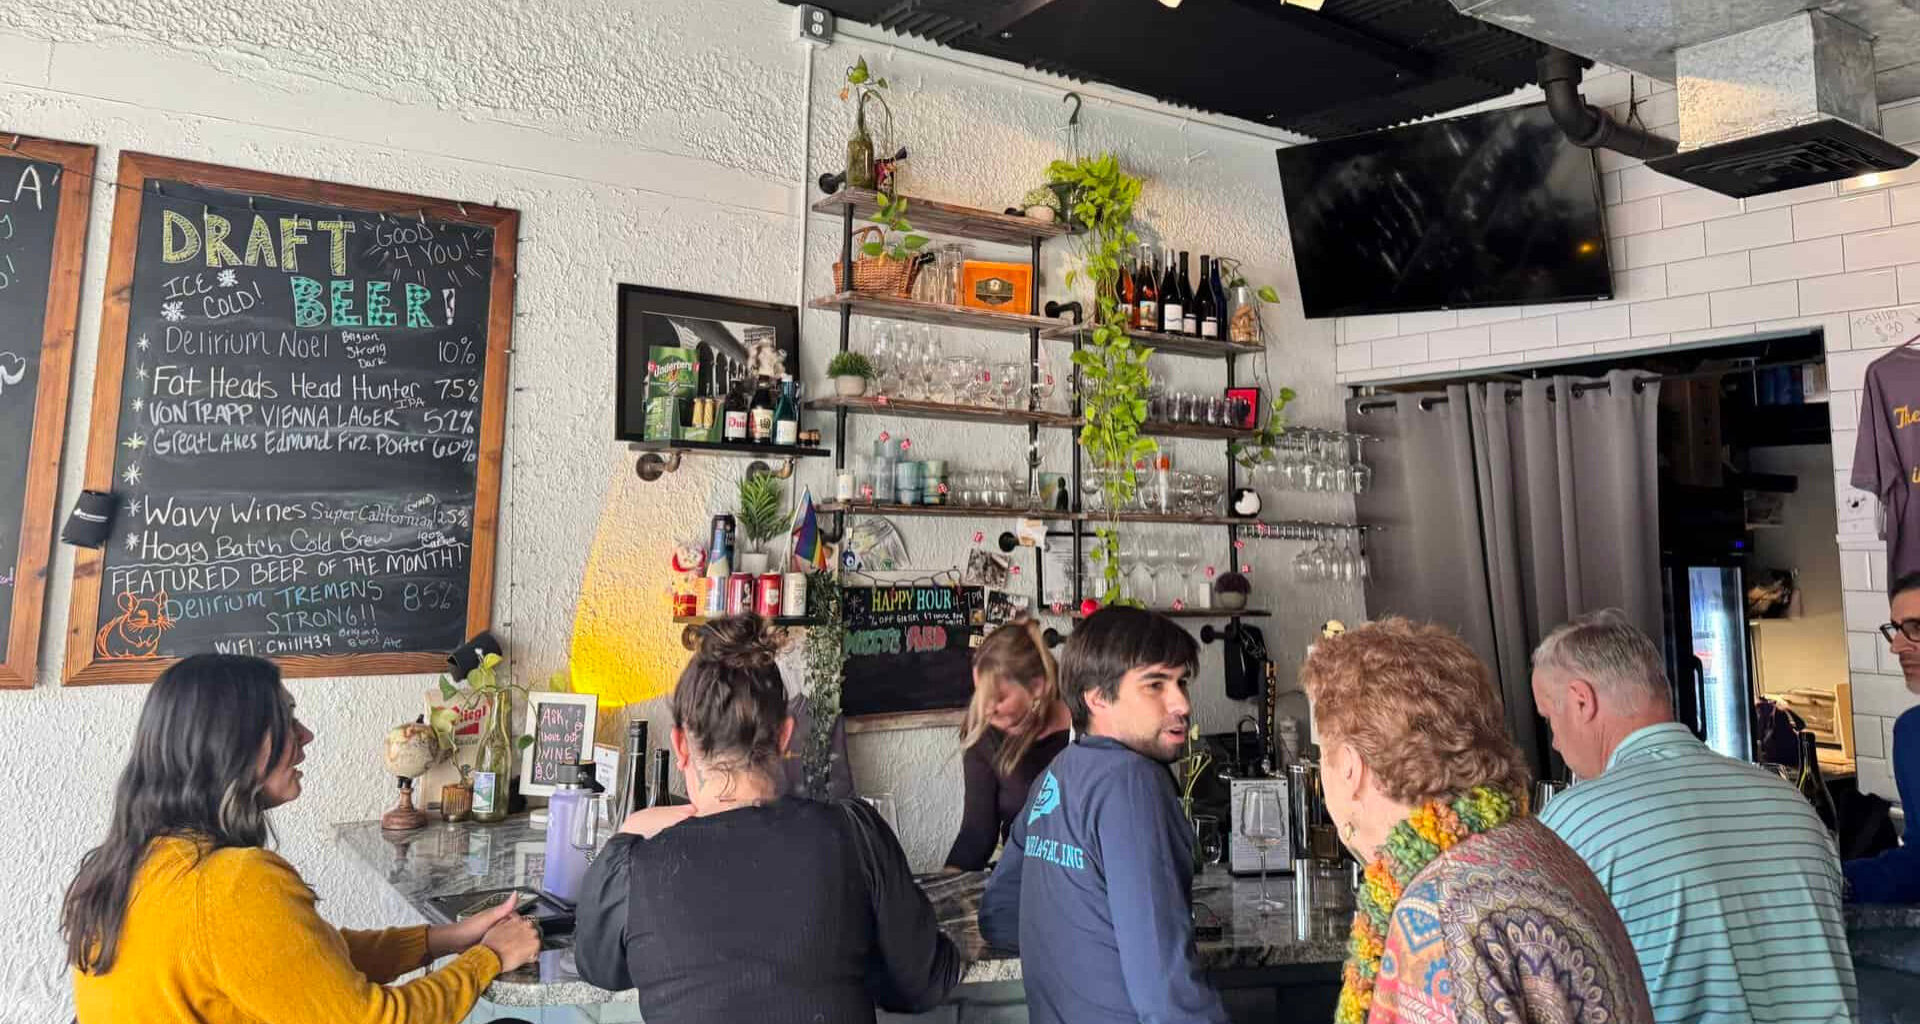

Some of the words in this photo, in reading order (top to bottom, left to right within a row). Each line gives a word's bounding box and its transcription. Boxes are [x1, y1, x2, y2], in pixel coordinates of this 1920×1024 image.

[162, 209, 356, 276] DRAFT
[376, 221, 434, 247] GOOD
[396, 246, 413, 268] 4
[162, 273, 213, 300] ICE
[203, 281, 265, 319] COLD!
[166, 326, 271, 355] Delirium
[279, 331, 328, 358] Noel
[438, 336, 477, 365] 10%
[346, 343, 386, 358] Strong
[358, 358, 387, 368] Dark
[153, 365, 202, 396] Fat
[210, 366, 278, 400] Heads
[291, 372, 341, 399] Head
[353, 373, 421, 400] Hunter
[261, 404, 329, 430] VIENNA
[338, 404, 400, 428] LAGER
[395, 397, 425, 410] IPA
[144, 494, 222, 534] Wavy
[231, 496, 306, 523] Wines
[142, 530, 209, 563] Hogg
[215, 533, 283, 559] Batch
[290, 527, 332, 553] Cold
[341, 528, 393, 550] Brew
[112, 566, 240, 596] FEATURED
[251, 557, 307, 586] BEER
[318, 558, 337, 577] OF
[344, 554, 380, 576] THE
[386, 546, 463, 575] MONTH!
[275, 580, 383, 608] TREMENS
[871, 589, 913, 612] HAPPY
[916, 588, 951, 611] HOUR
[266, 603, 377, 635] STRONG!!
